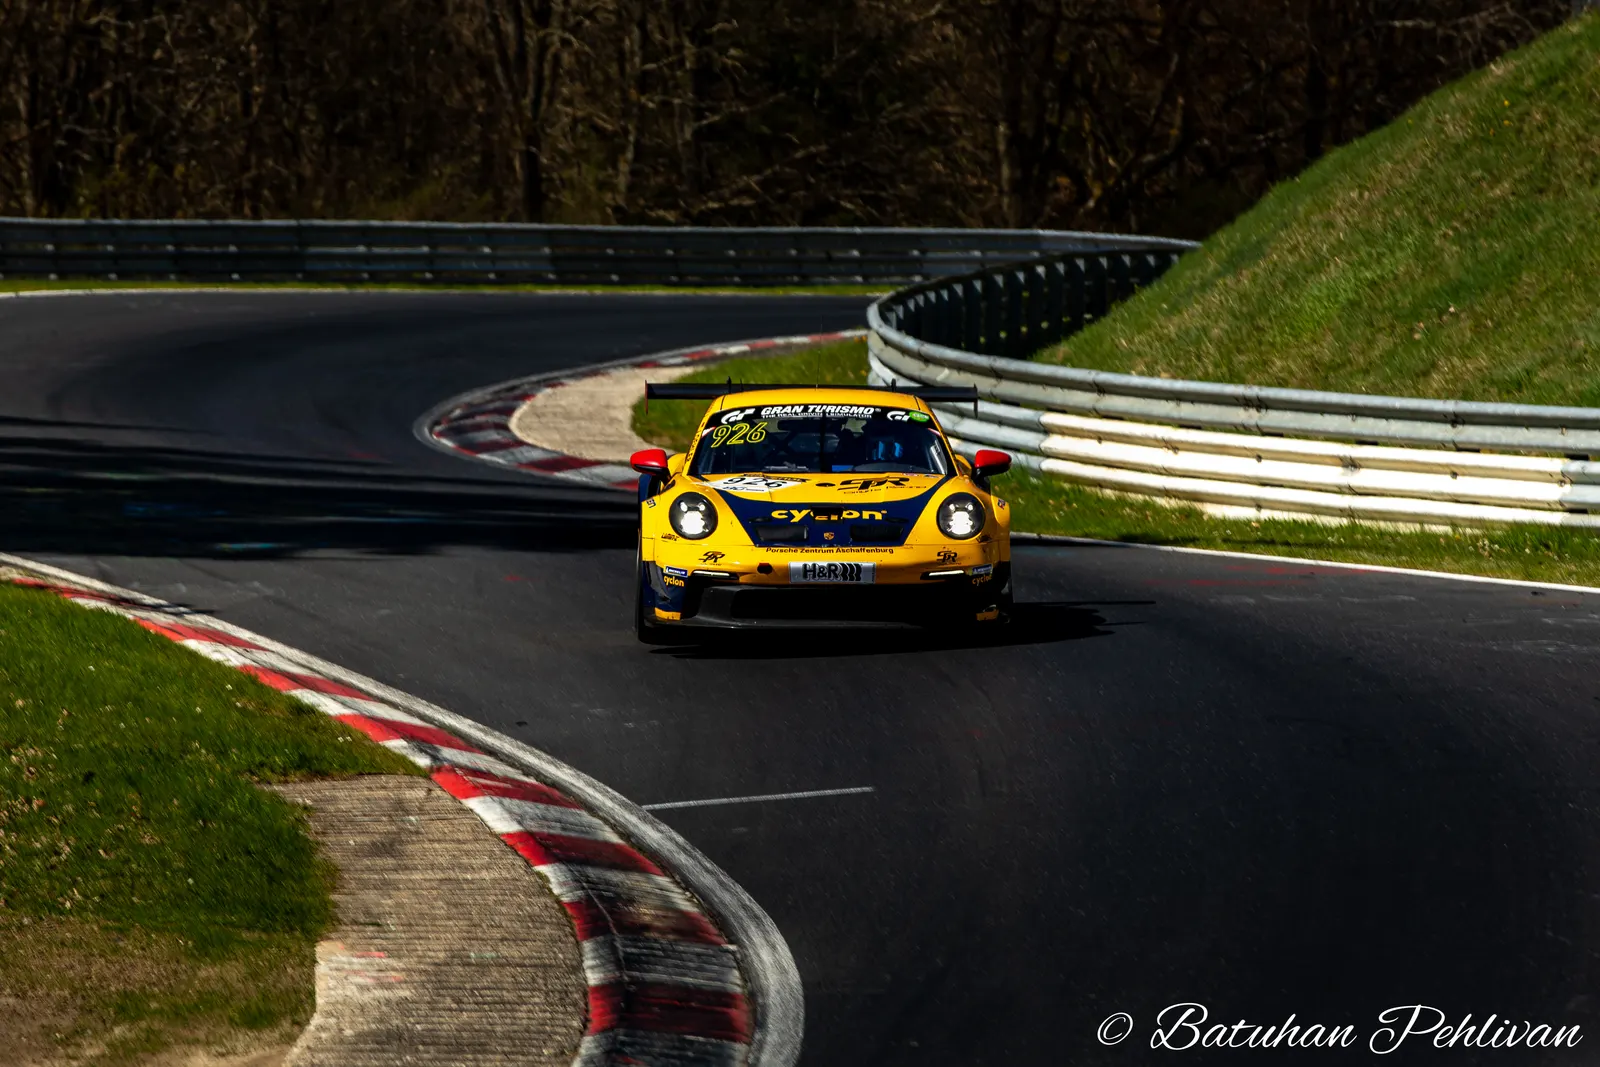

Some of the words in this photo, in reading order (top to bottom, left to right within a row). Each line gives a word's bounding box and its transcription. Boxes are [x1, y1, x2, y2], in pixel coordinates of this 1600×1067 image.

[761, 405, 804, 416] GRAN
[808, 405, 875, 415] TURISMO
[711, 422, 768, 448] 926
[723, 477, 788, 488] 926
[802, 563, 840, 580] H&R
[663, 575, 685, 587] cyclon
